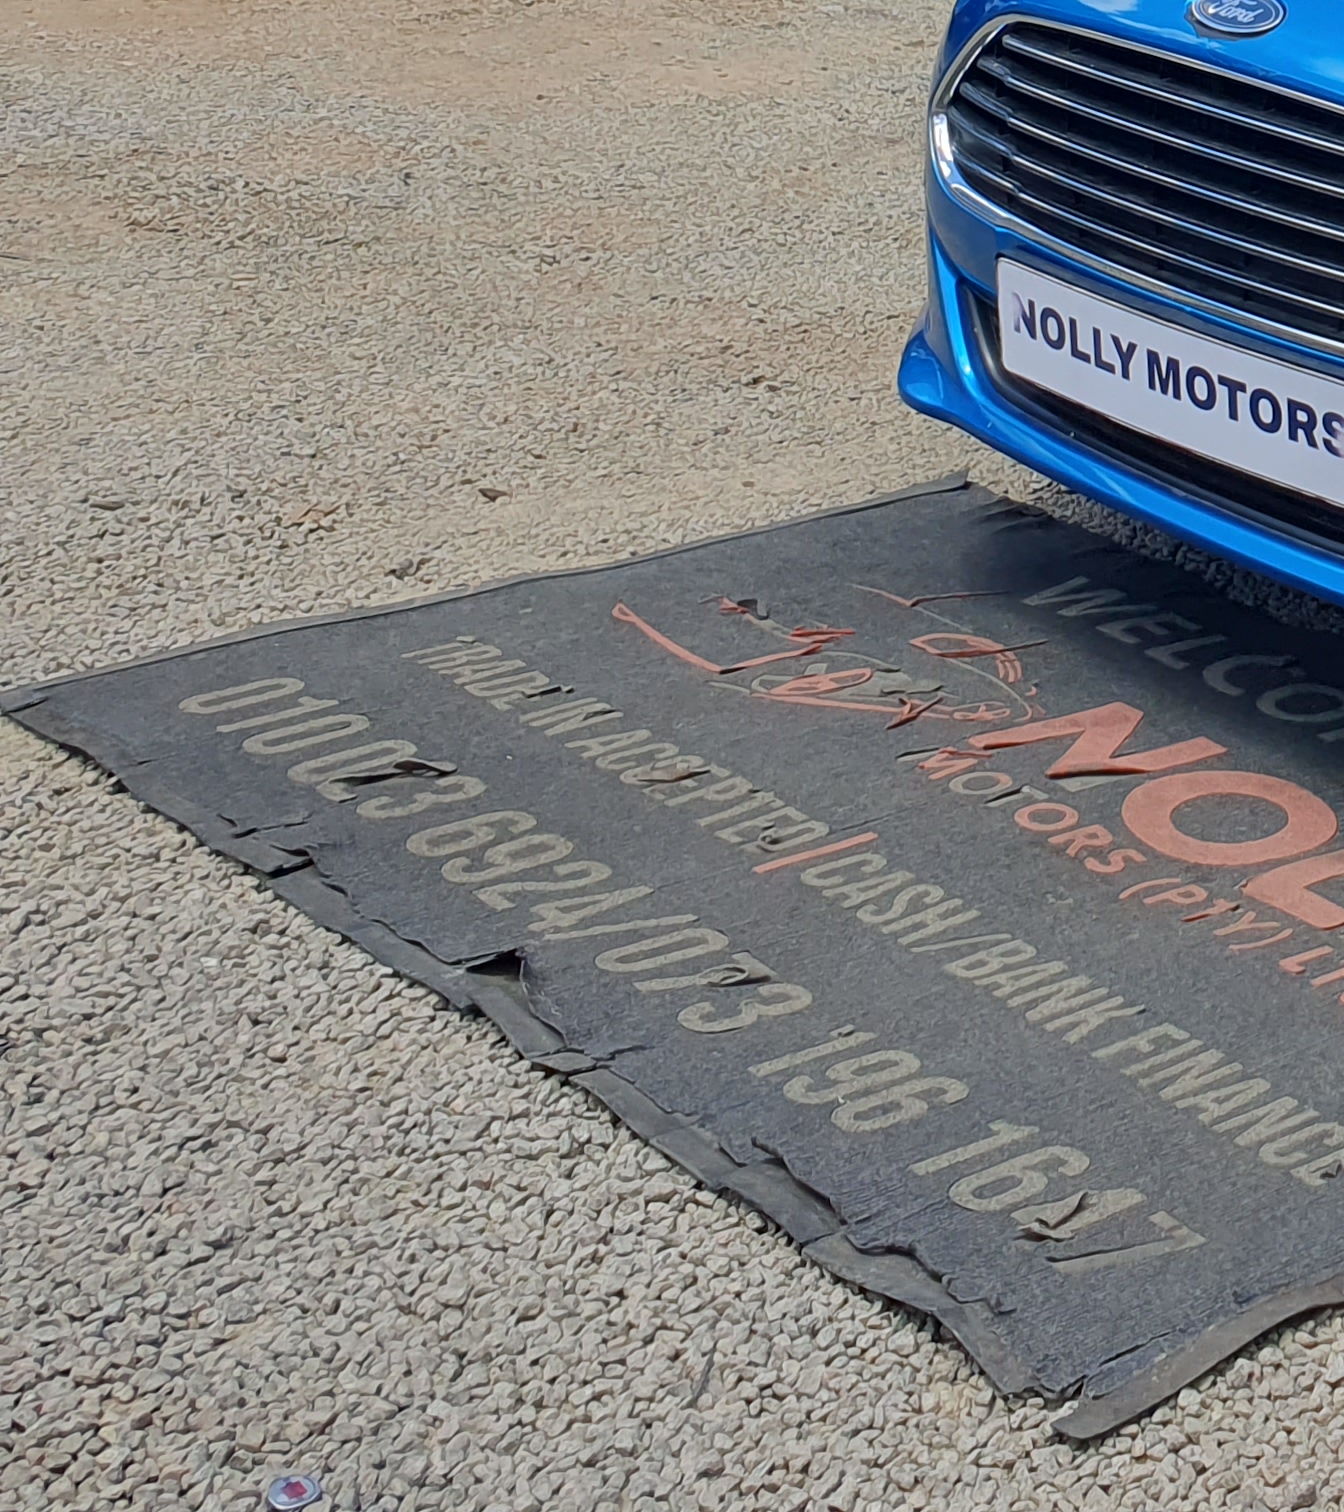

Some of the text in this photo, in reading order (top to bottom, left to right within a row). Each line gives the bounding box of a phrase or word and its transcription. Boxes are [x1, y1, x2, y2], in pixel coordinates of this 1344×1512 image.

[1012, 291, 1138, 382] NOLLY
[519, 697, 624, 737] IN
[905, 746, 1148, 874] MOTORS
[747, 1024, 970, 1133] 196
